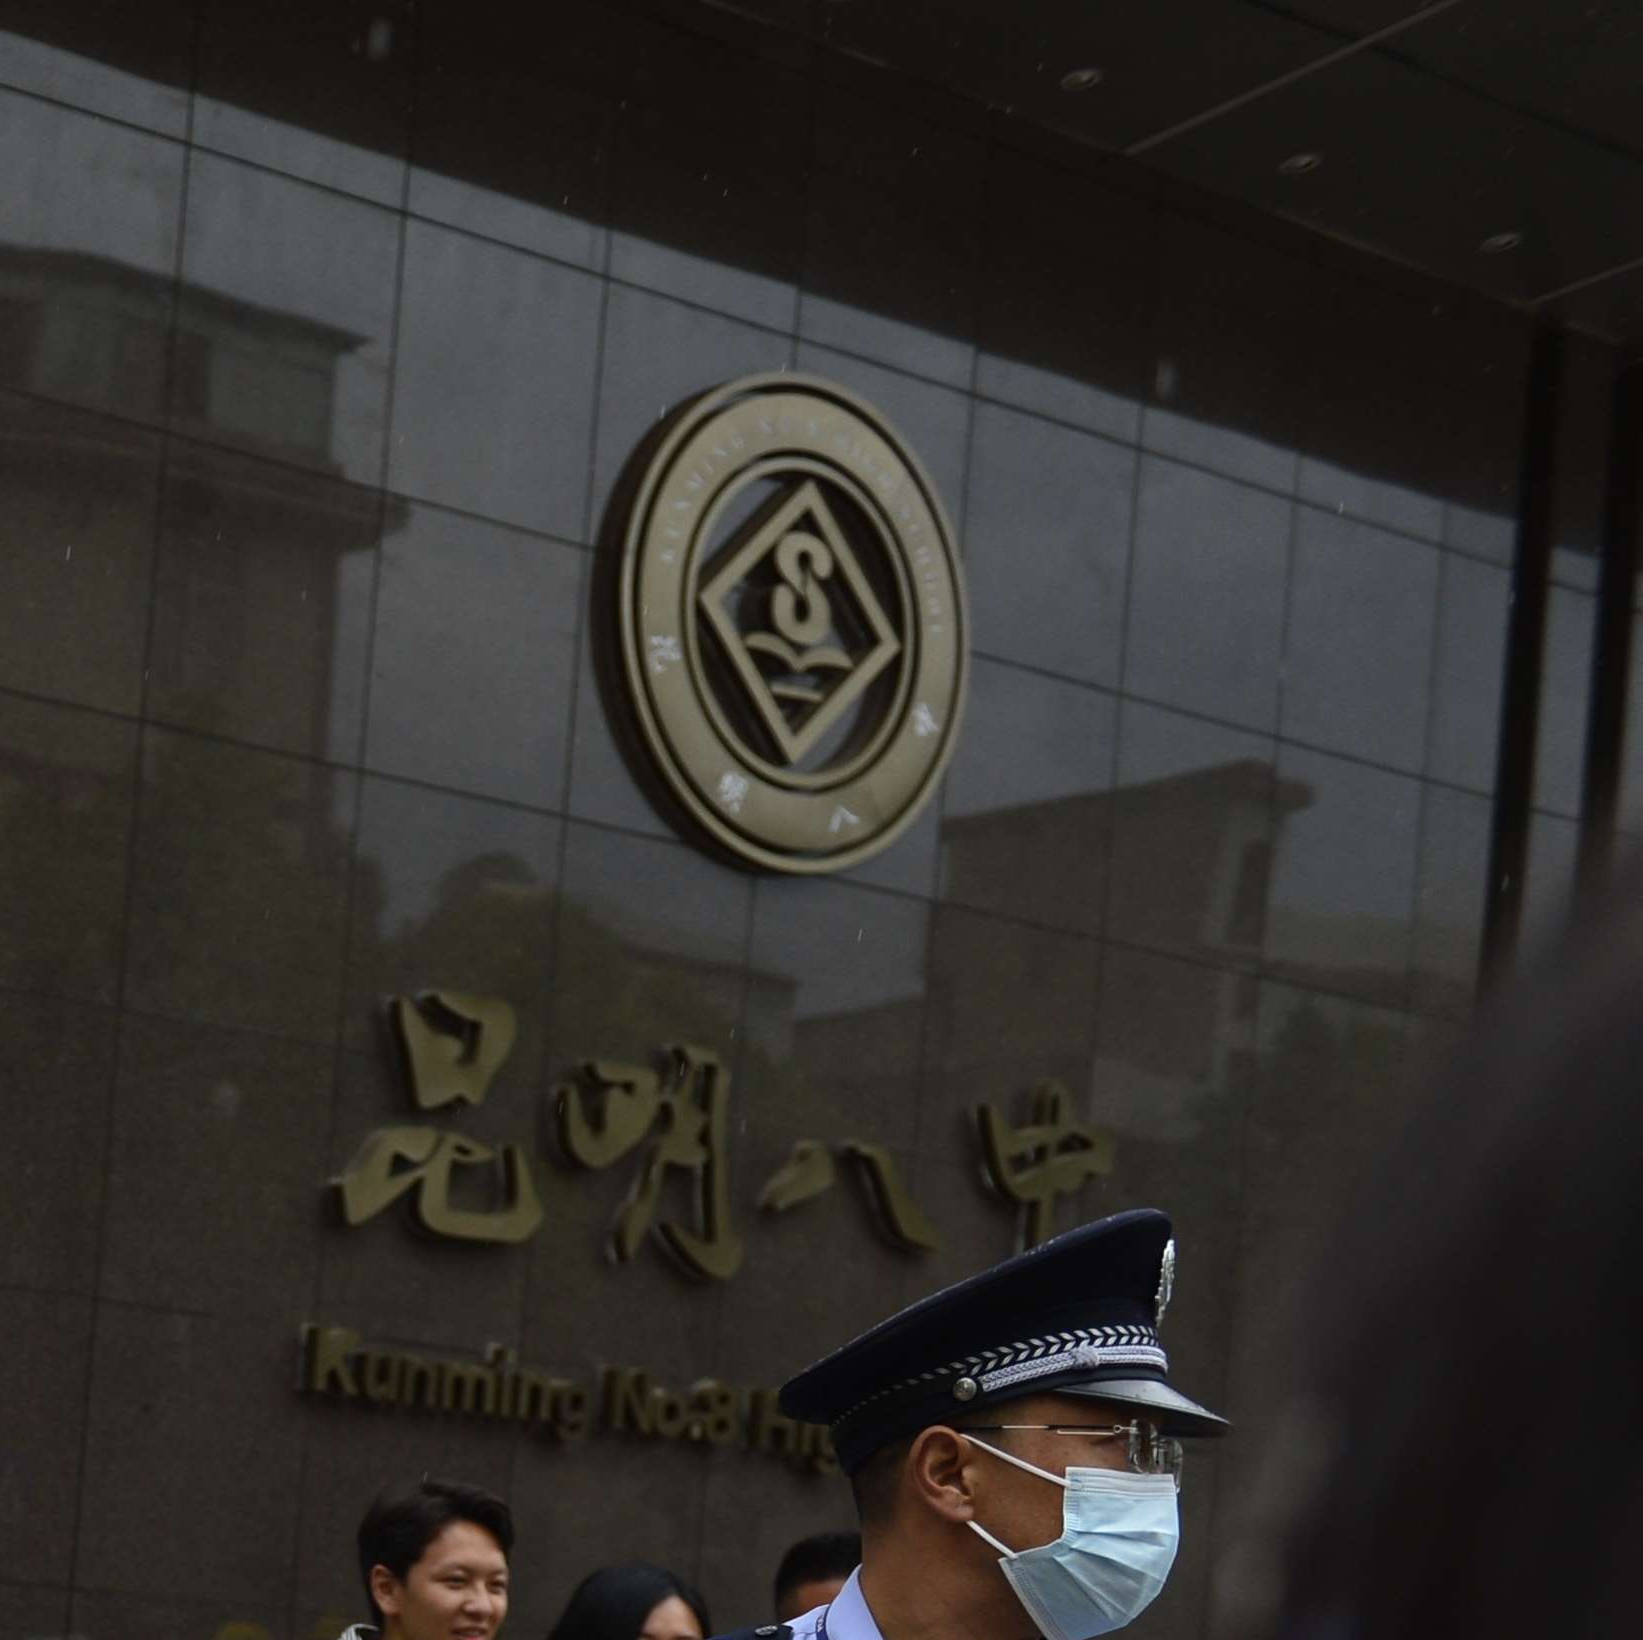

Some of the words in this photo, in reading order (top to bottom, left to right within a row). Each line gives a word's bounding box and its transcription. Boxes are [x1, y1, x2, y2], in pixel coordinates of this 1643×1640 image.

[325, 988, 1117, 1282] 昆明八中
[301, 1322, 589, 1441] Kunming
[600, 1365, 739, 1442] No.8
